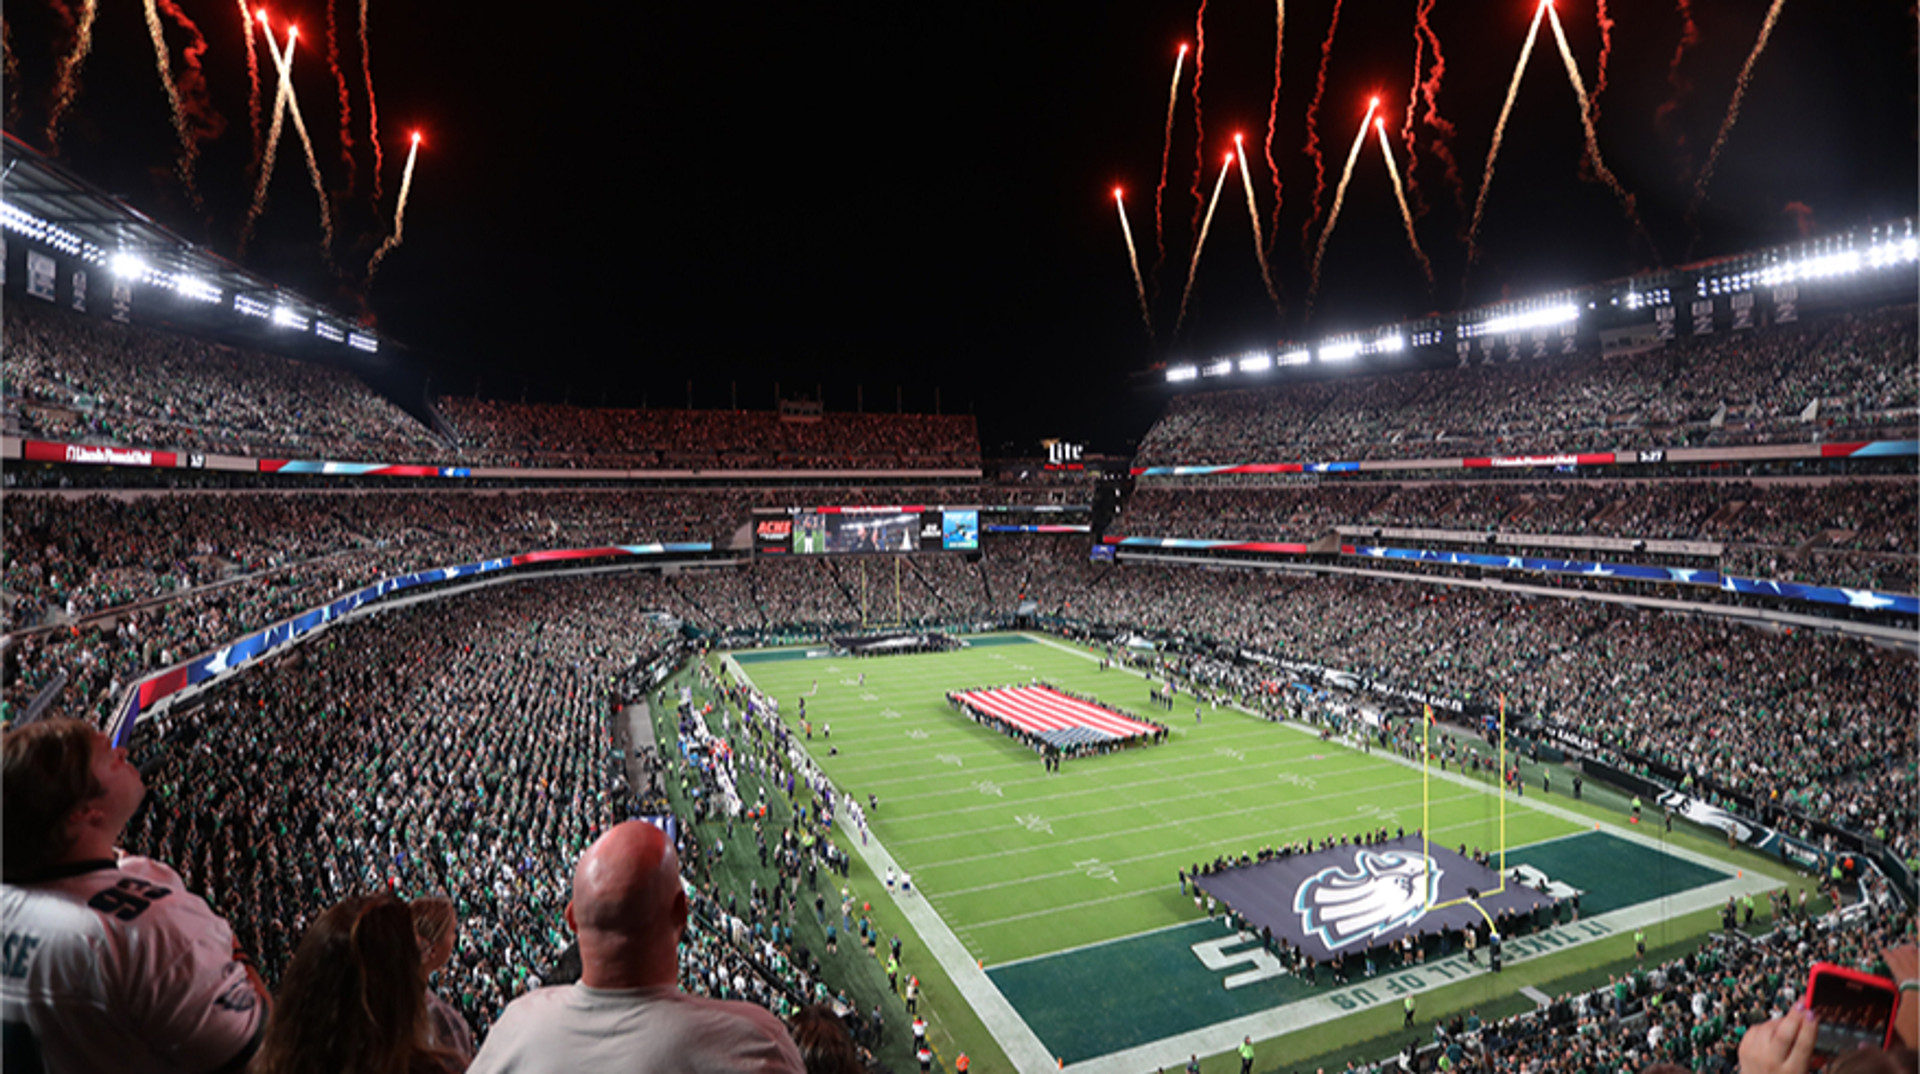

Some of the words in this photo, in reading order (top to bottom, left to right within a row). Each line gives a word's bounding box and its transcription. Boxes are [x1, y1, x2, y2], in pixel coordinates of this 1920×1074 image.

[1049, 442, 1084, 464] Lite
[1584, 920, 1611, 936] IT
[1386, 973, 1425, 996] OF
[1329, 988, 1379, 1011] US
